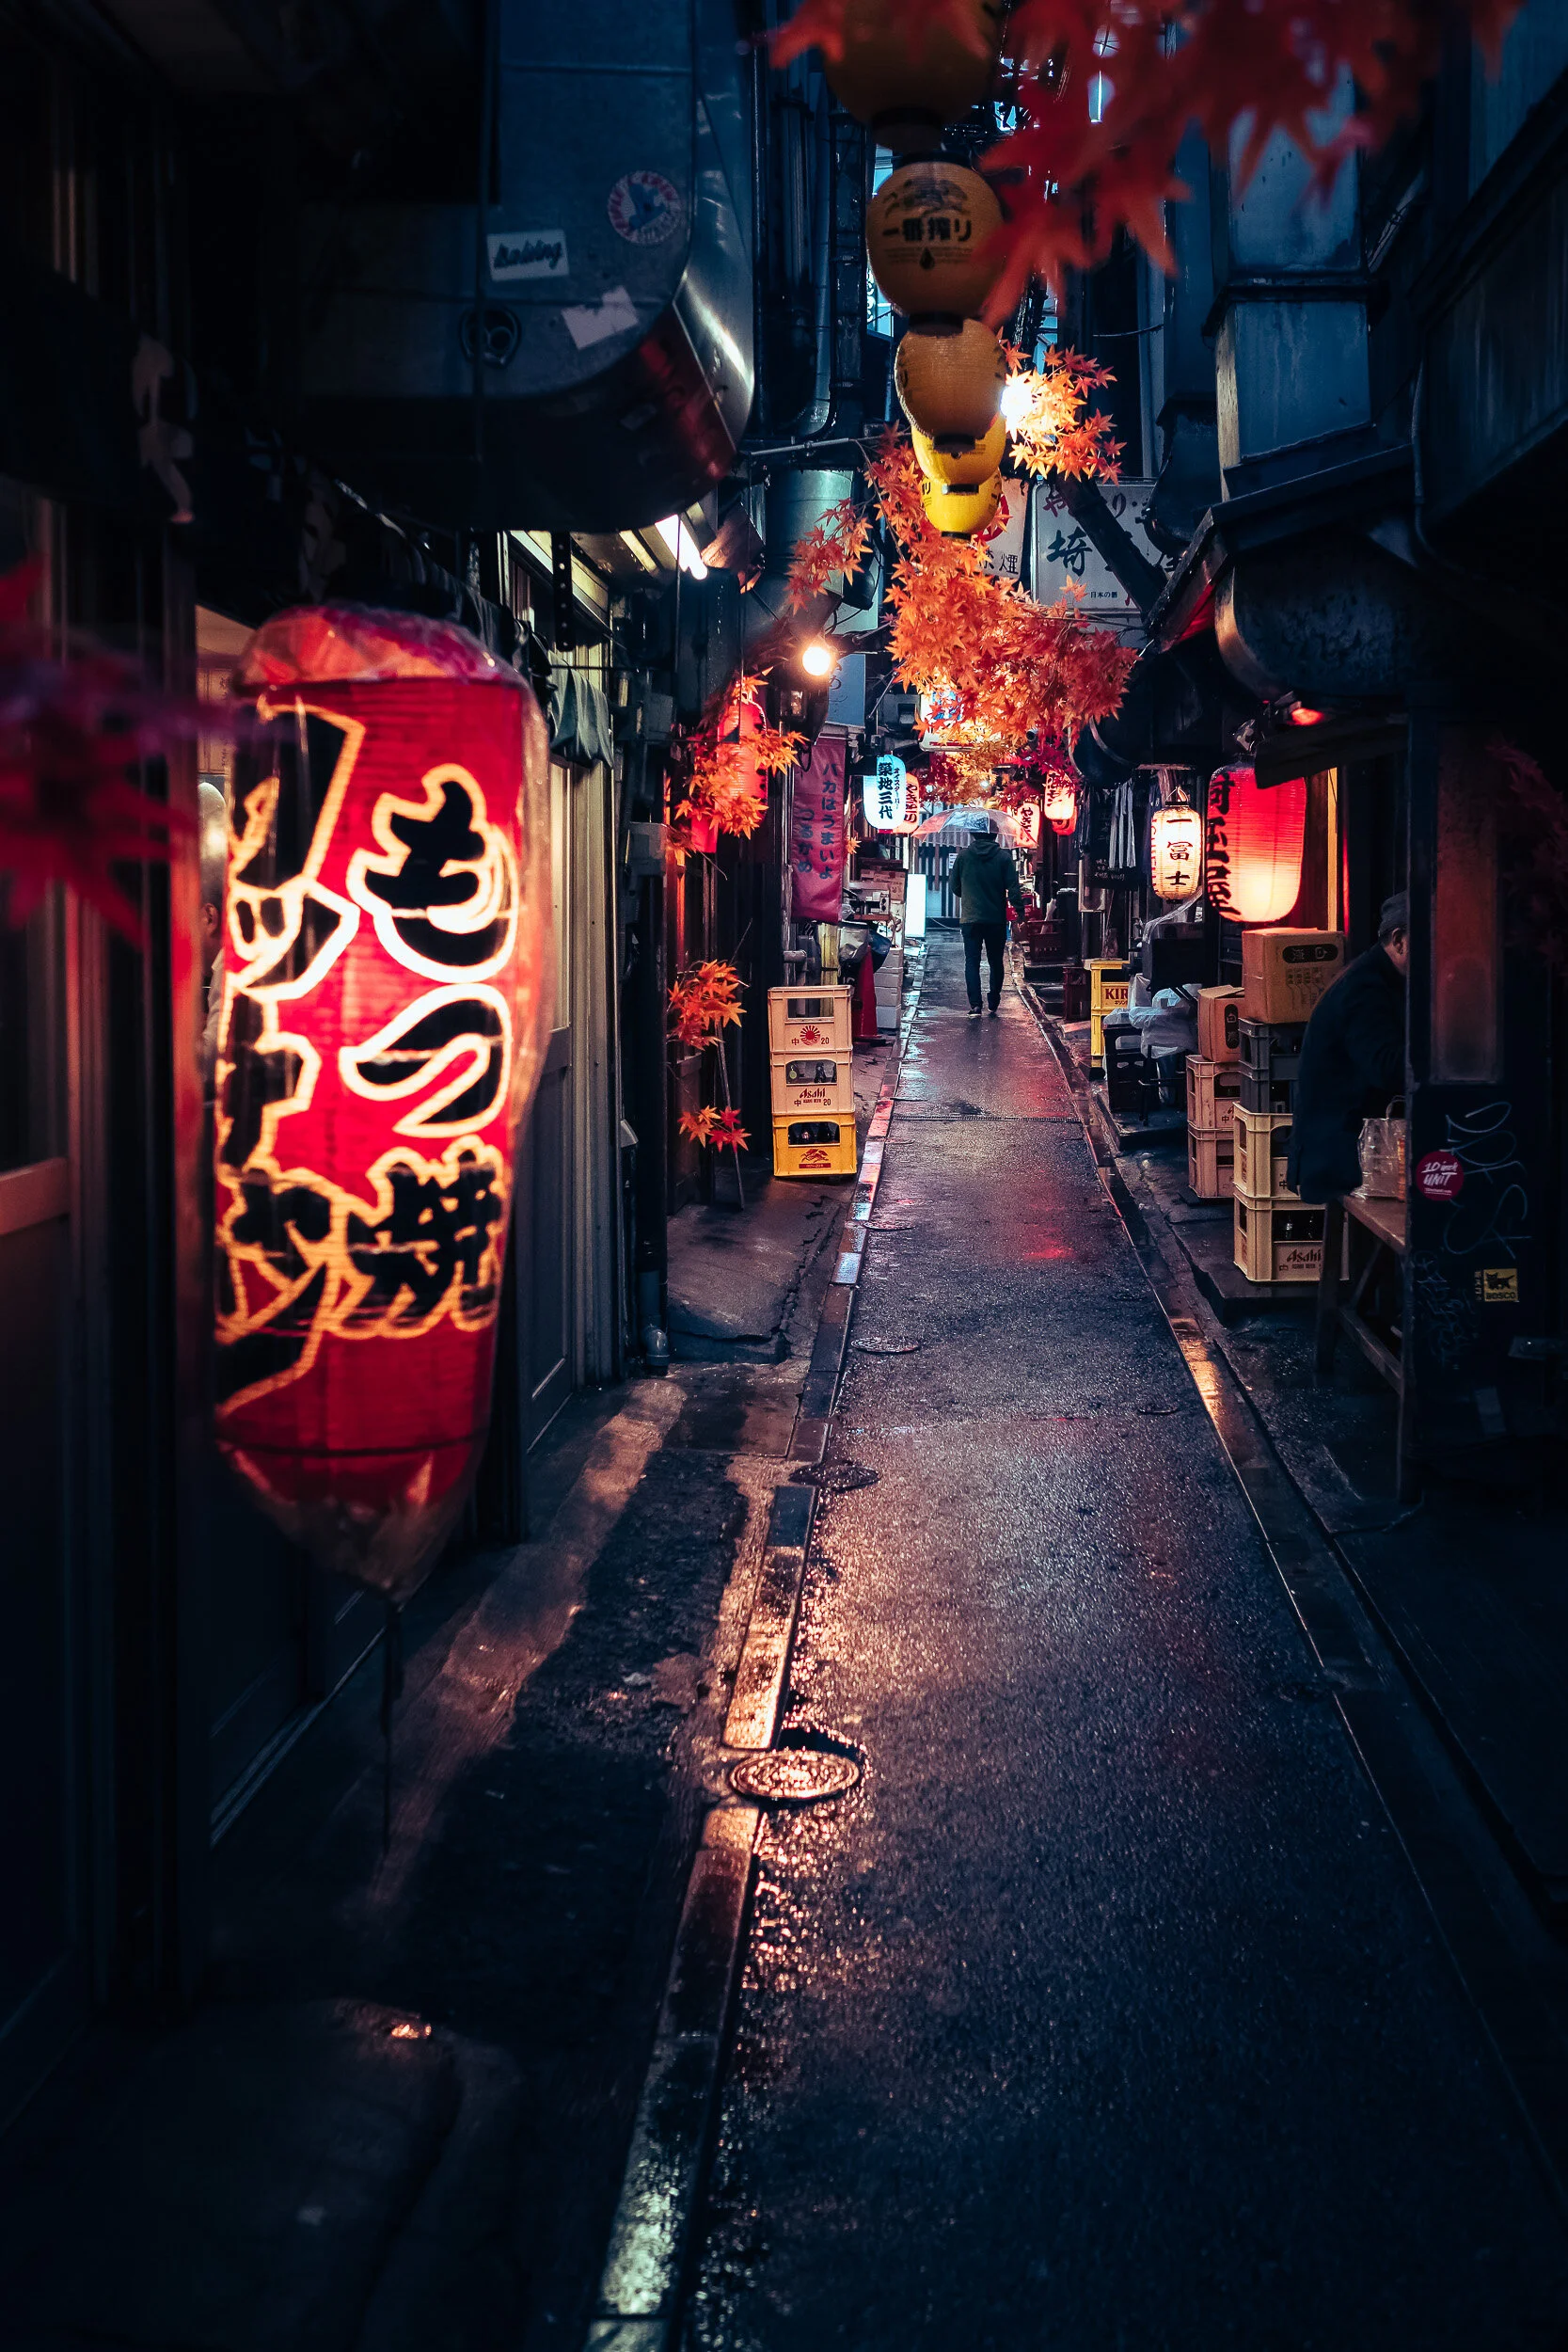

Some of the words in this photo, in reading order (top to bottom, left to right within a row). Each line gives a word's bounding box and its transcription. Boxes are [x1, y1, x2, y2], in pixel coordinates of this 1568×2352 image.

[881, 217, 973, 242] 一番搾り
[877, 761, 894, 819] 築地三代
[797, 807, 815, 874] つるかめ
[791, 1038, 800, 1046] 中
[821, 1037, 830, 1045] 20
[340, 760, 519, 1338] もつ焼
[799, 1088, 826, 1099] Asahi
[794, 1099, 801, 1107] 中
[823, 1098, 832, 1106] 20
[1222, 1116, 1229, 1124] 中
[1278, 1179, 1288, 1189] 中
[1423, 1171, 1457, 1186] UNIT
[1286, 1248, 1322, 1263] Asahi
